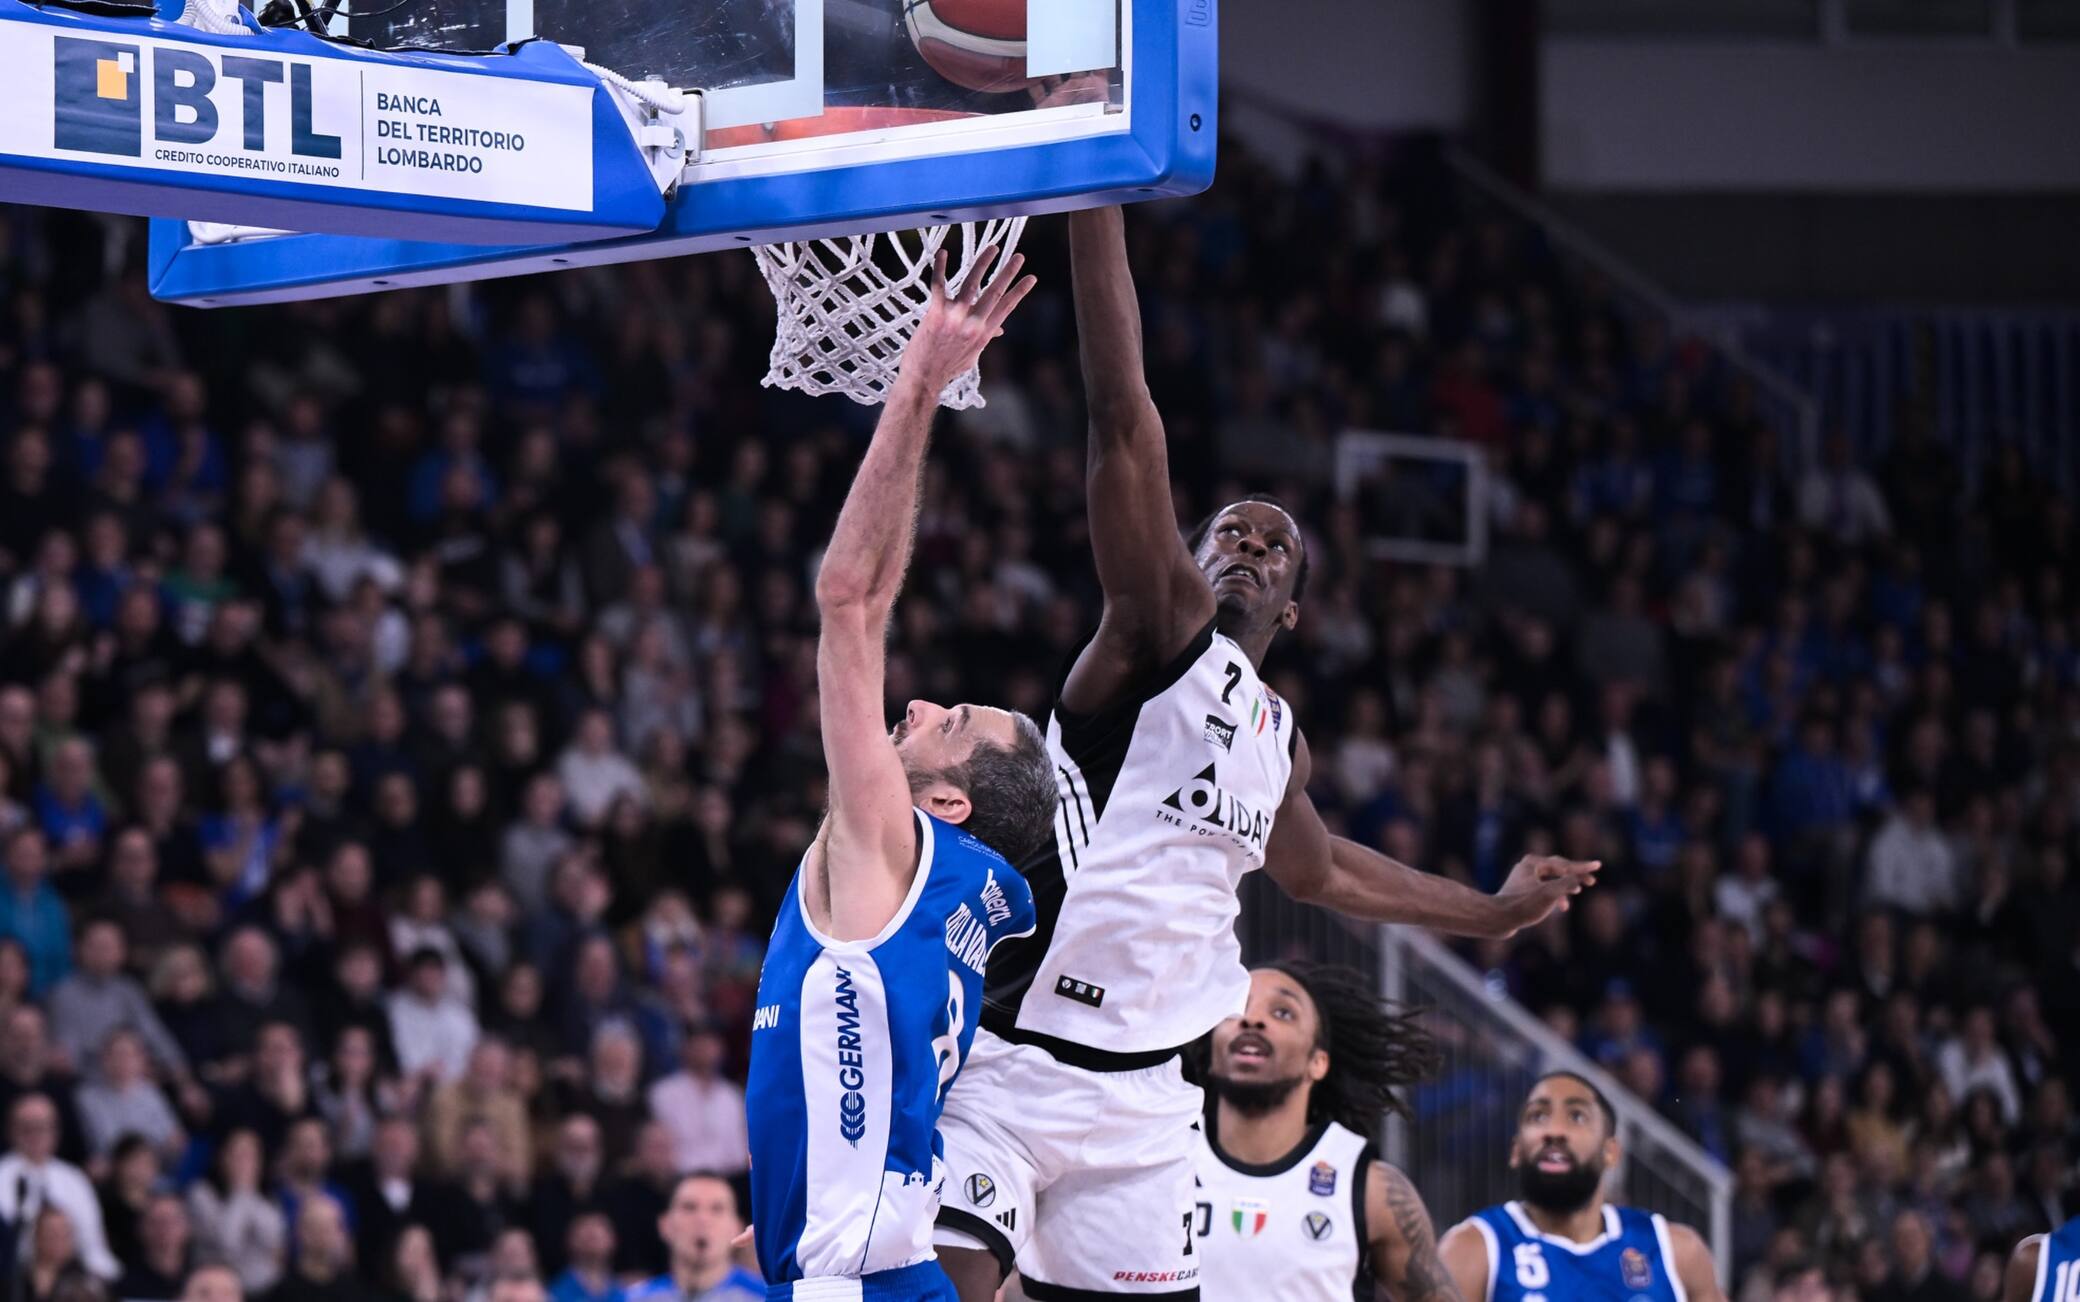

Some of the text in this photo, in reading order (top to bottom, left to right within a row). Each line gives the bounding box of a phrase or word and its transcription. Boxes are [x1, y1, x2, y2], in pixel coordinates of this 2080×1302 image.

[154, 47, 342, 160] BTL
[377, 92, 442, 116] BANCA
[378, 119, 524, 151] DEL TERRITORIO
[155, 149, 340, 178] CREDITO COOPERATIVO ITALIANO
[378, 146, 482, 174] LOMBARDO
[1222, 660, 1242, 706] 7
[1156, 809, 1182, 827] THE
[1182, 1211, 1193, 1256] 7
[1513, 1242, 1550, 1289] 5
